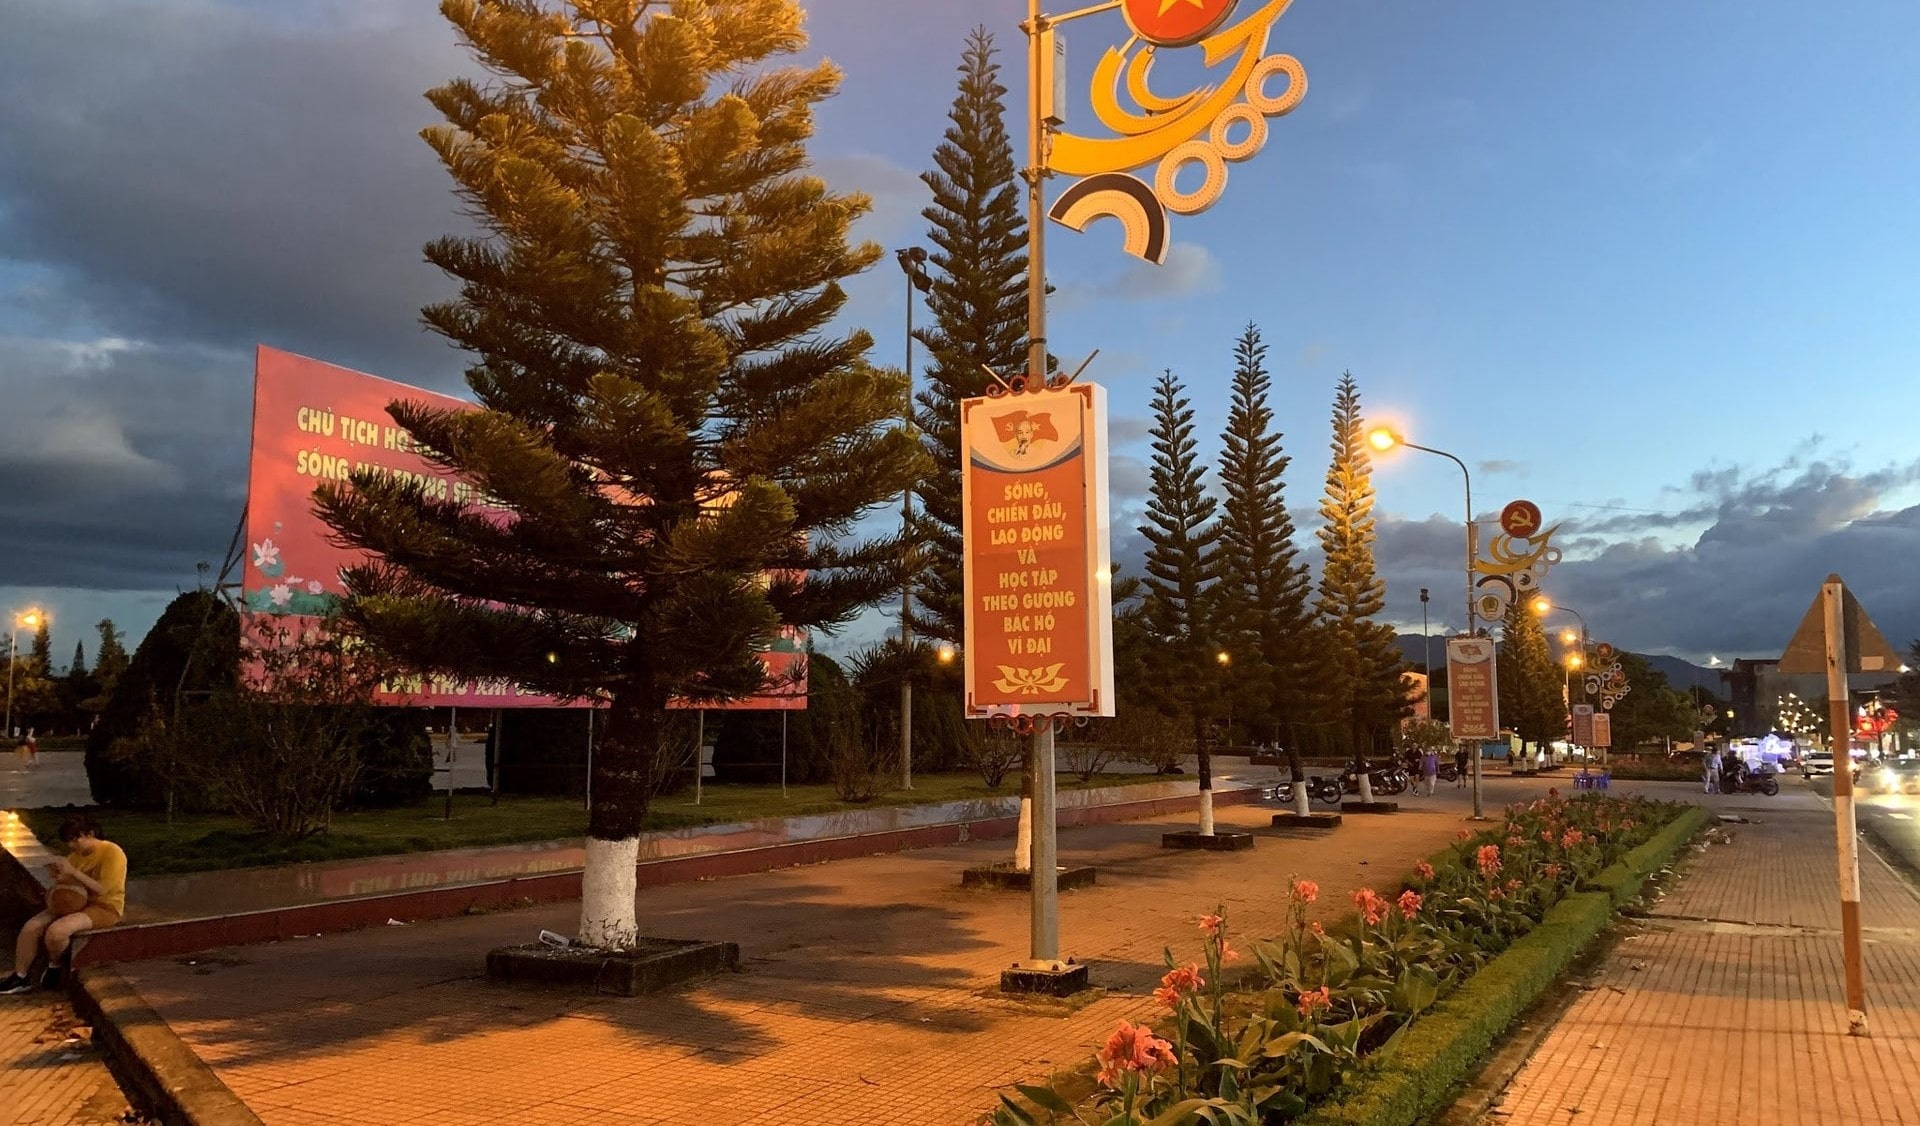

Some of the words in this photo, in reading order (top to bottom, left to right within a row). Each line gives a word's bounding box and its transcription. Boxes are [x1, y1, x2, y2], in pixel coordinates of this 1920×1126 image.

[297, 406, 335, 436] CHỦ
[340, 416, 378, 447] TỊCH
[297, 446, 349, 481] SỐNG
[1004, 479, 1049, 501] SỐNG,
[987, 501, 1028, 524] CHIẾN
[1032, 498, 1067, 521] ĐẤU,
[990, 528, 1017, 546] LAO
[1021, 523, 1064, 546] ĐỘNG
[1016, 545, 1038, 565] VÀ
[999, 571, 1028, 592] HỌC
[1031, 567, 1058, 589] TẬP
[982, 594, 1018, 612] THEO
[1022, 590, 1076, 609] GƯƠNG
[1003, 612, 1030, 633] BÁC
[1026, 637, 1051, 658] ĐẠI
